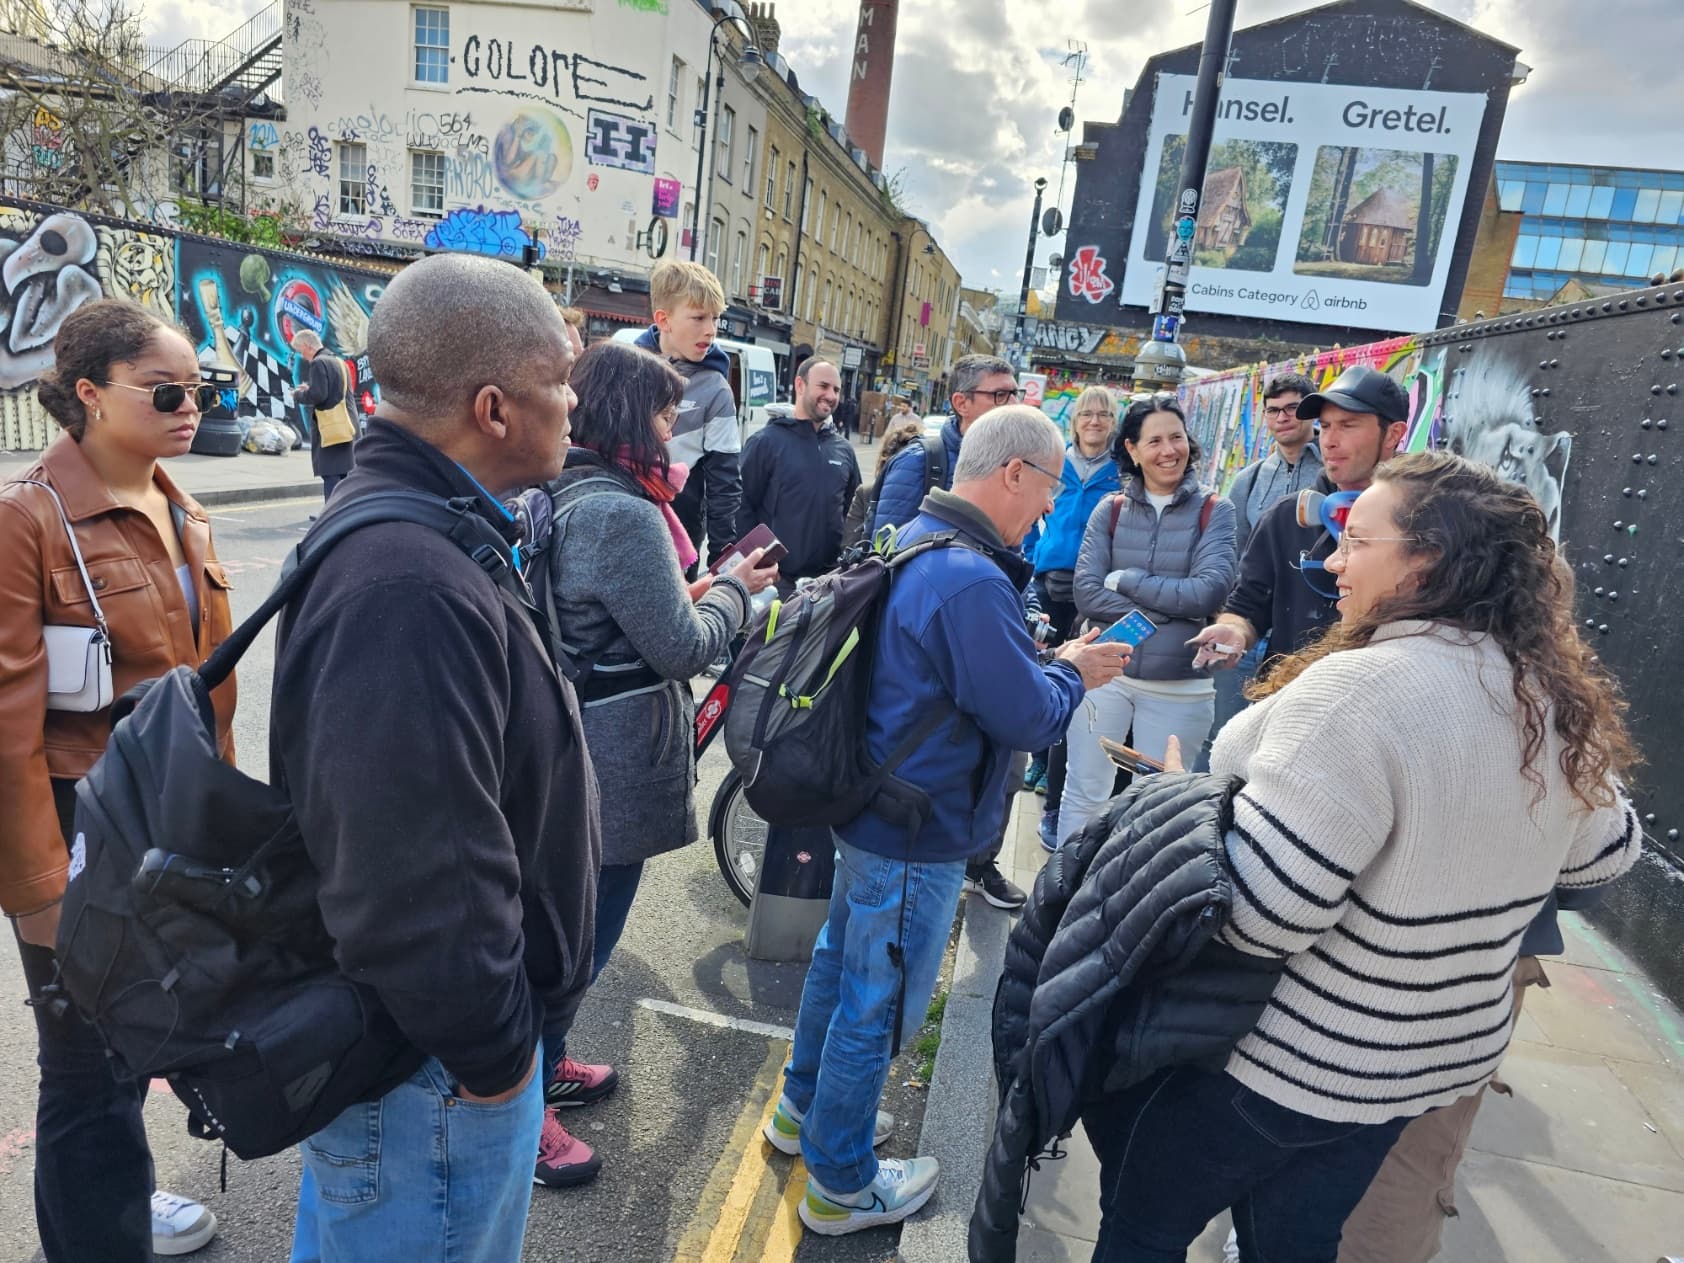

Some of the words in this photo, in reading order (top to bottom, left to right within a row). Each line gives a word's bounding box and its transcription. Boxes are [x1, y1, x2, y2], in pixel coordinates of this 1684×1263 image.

[1182, 90, 1295, 124] Hnsel.
[1342, 100, 1451, 134] Gretel.
[1192, 284, 1234, 298] Cabins
[1237, 287, 1298, 306] Category
[1324, 296, 1368, 310] airbnb
